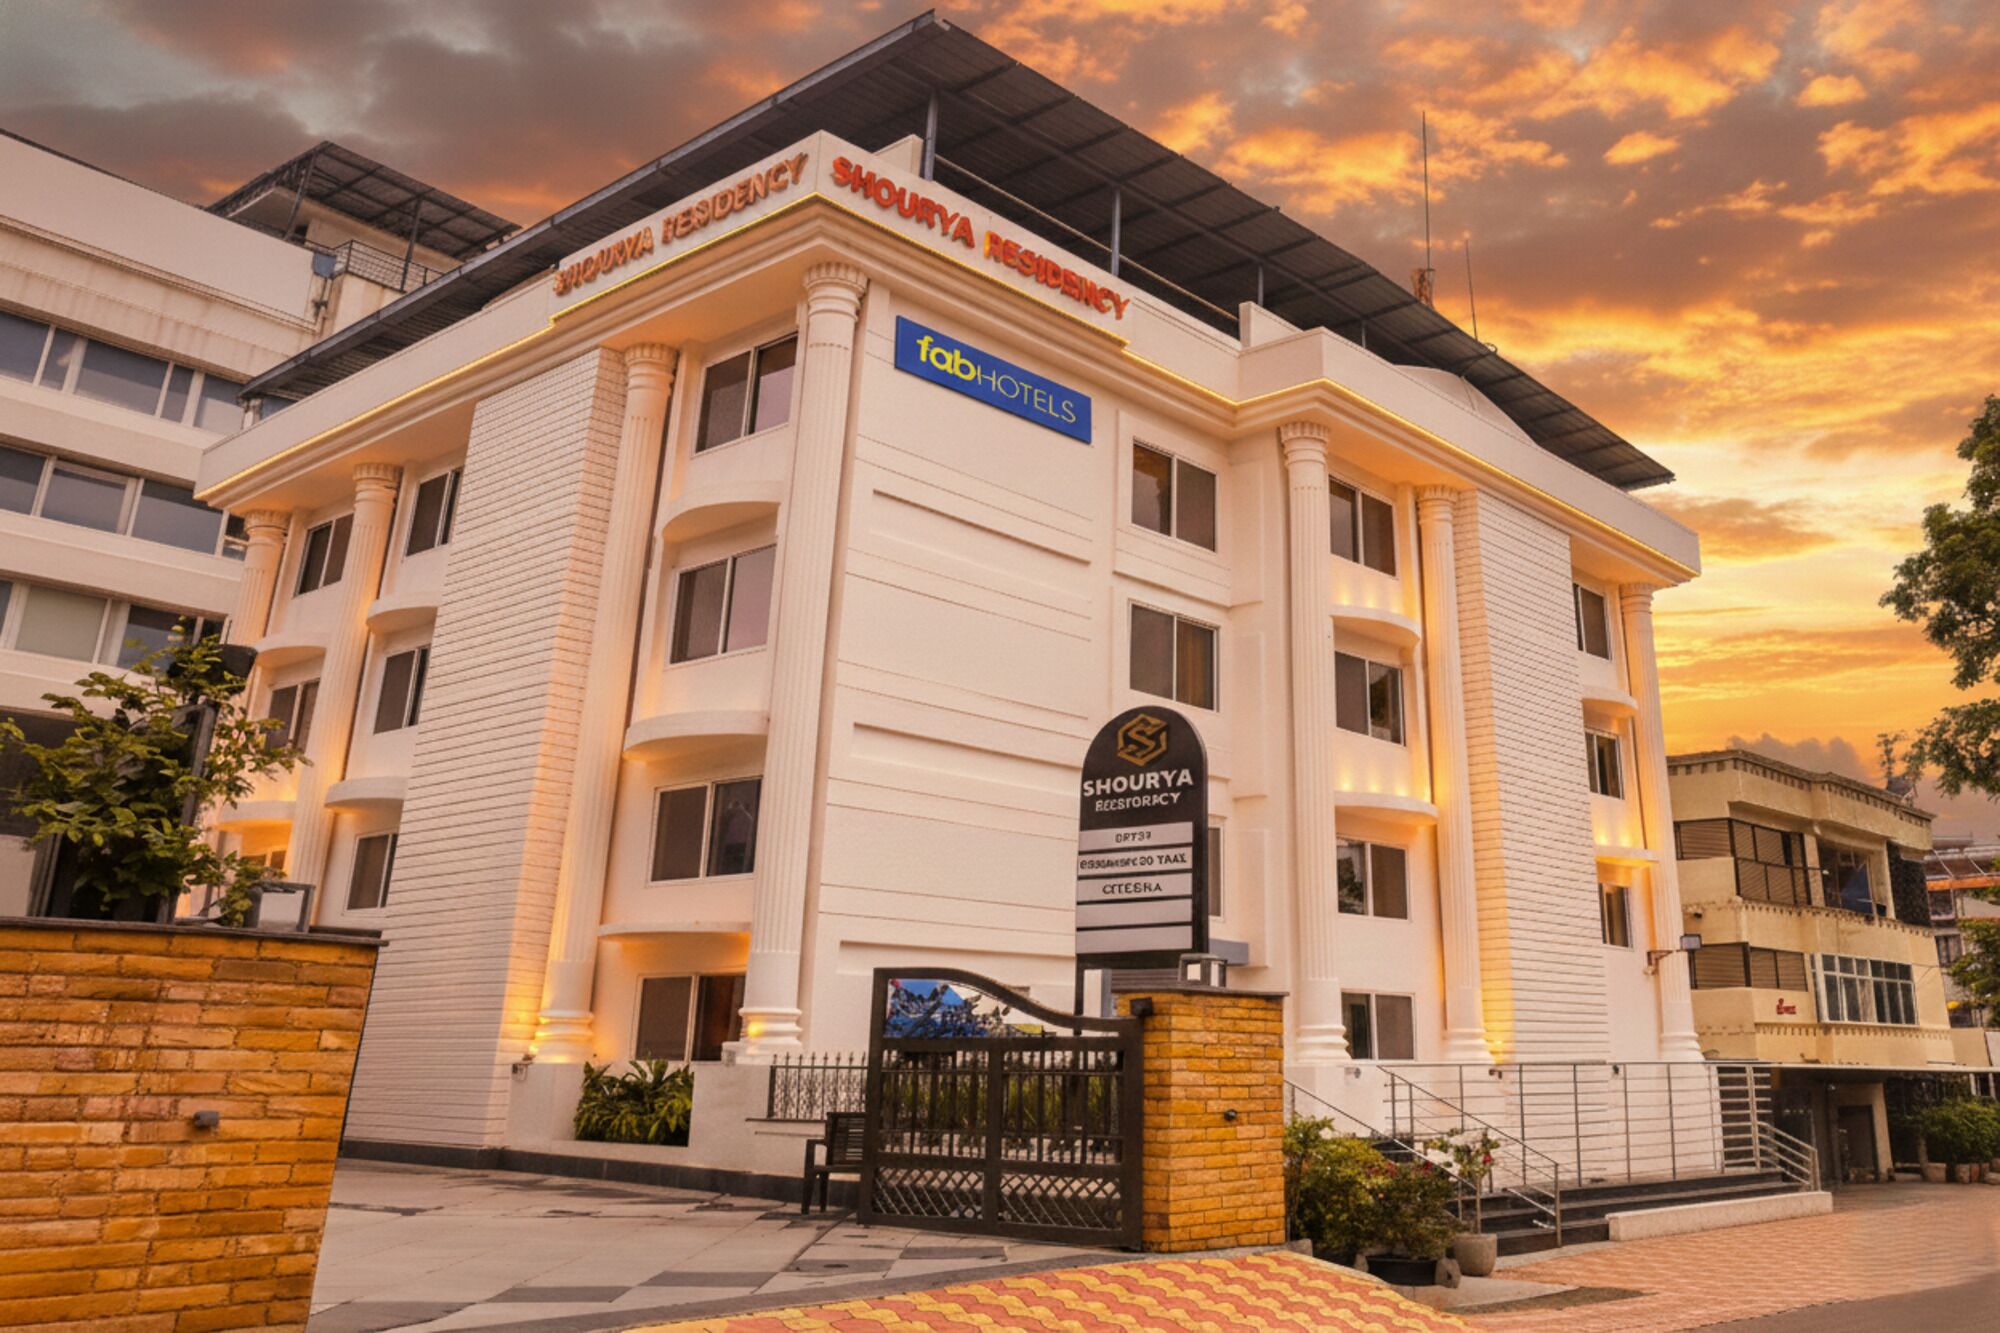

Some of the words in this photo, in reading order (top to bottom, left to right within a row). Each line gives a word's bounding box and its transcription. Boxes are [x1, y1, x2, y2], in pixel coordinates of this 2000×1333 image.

[831, 156, 975, 249] SHOURYA
[983, 230, 1130, 320] RESIDENCY
[916, 335, 1077, 424] fabHOTELS
[1082, 768, 1194, 797] SHOURYA
